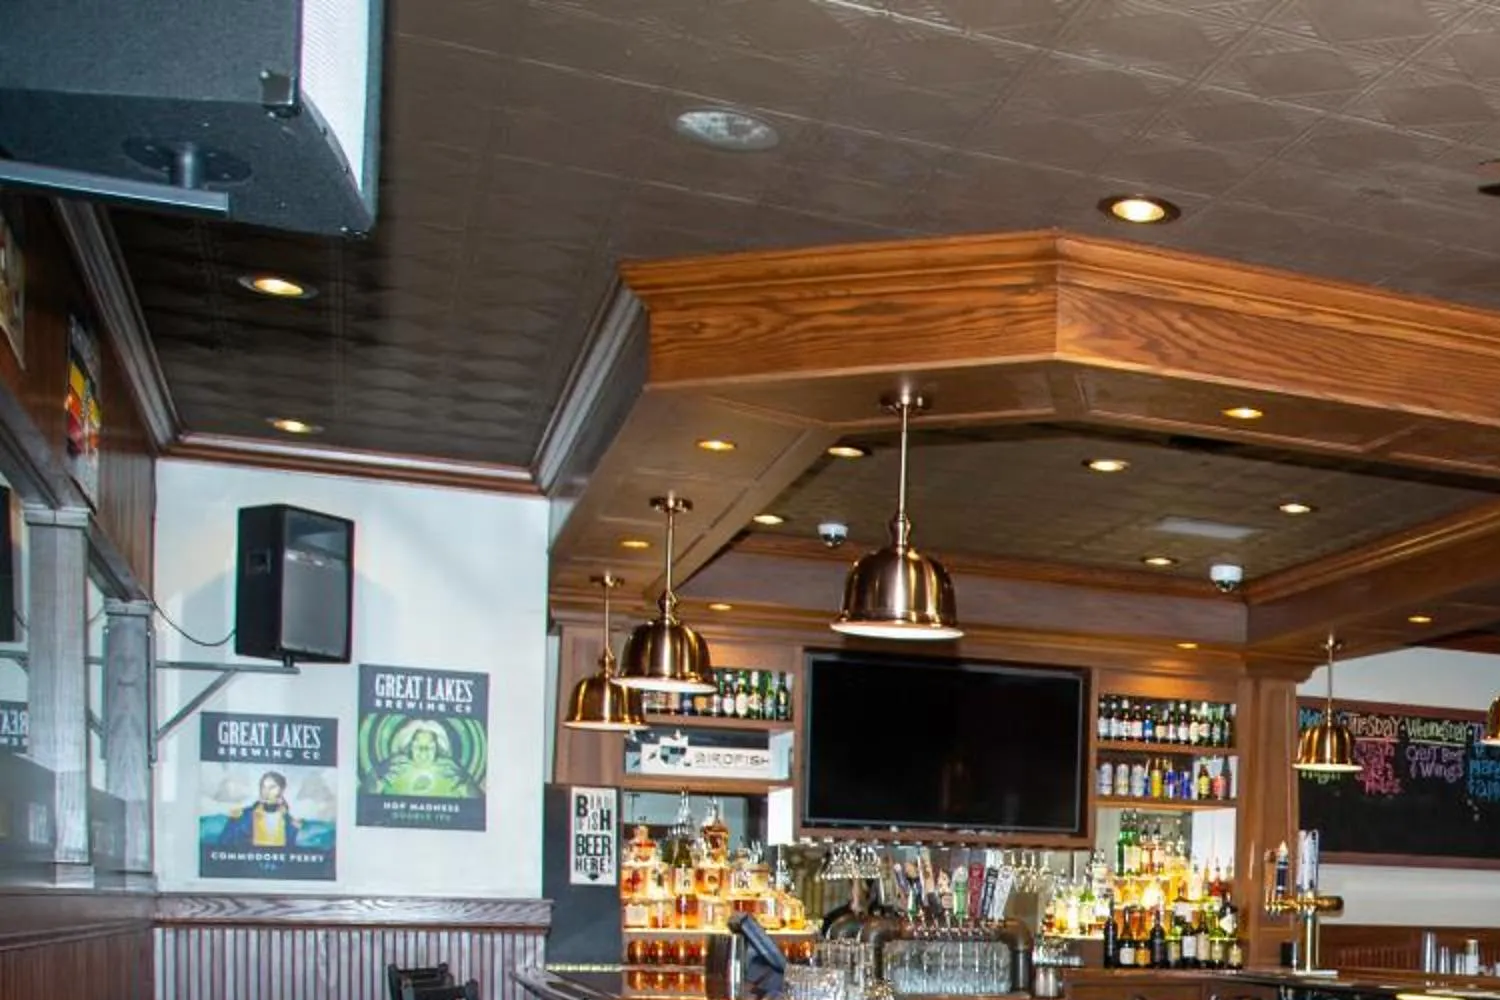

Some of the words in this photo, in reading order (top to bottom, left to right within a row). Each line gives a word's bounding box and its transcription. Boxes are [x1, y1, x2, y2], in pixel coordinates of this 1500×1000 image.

[375, 673, 423, 700] GREAT
[426, 677, 473, 703] LAKES
[375, 699, 446, 712] BREWING
[218, 721, 268, 747] GREAT
[272, 722, 321, 749] LAKES
[217, 747, 294, 759] BREWING
[576, 833, 611, 857] BEER
[210, 852, 286, 862] COMMODORE
